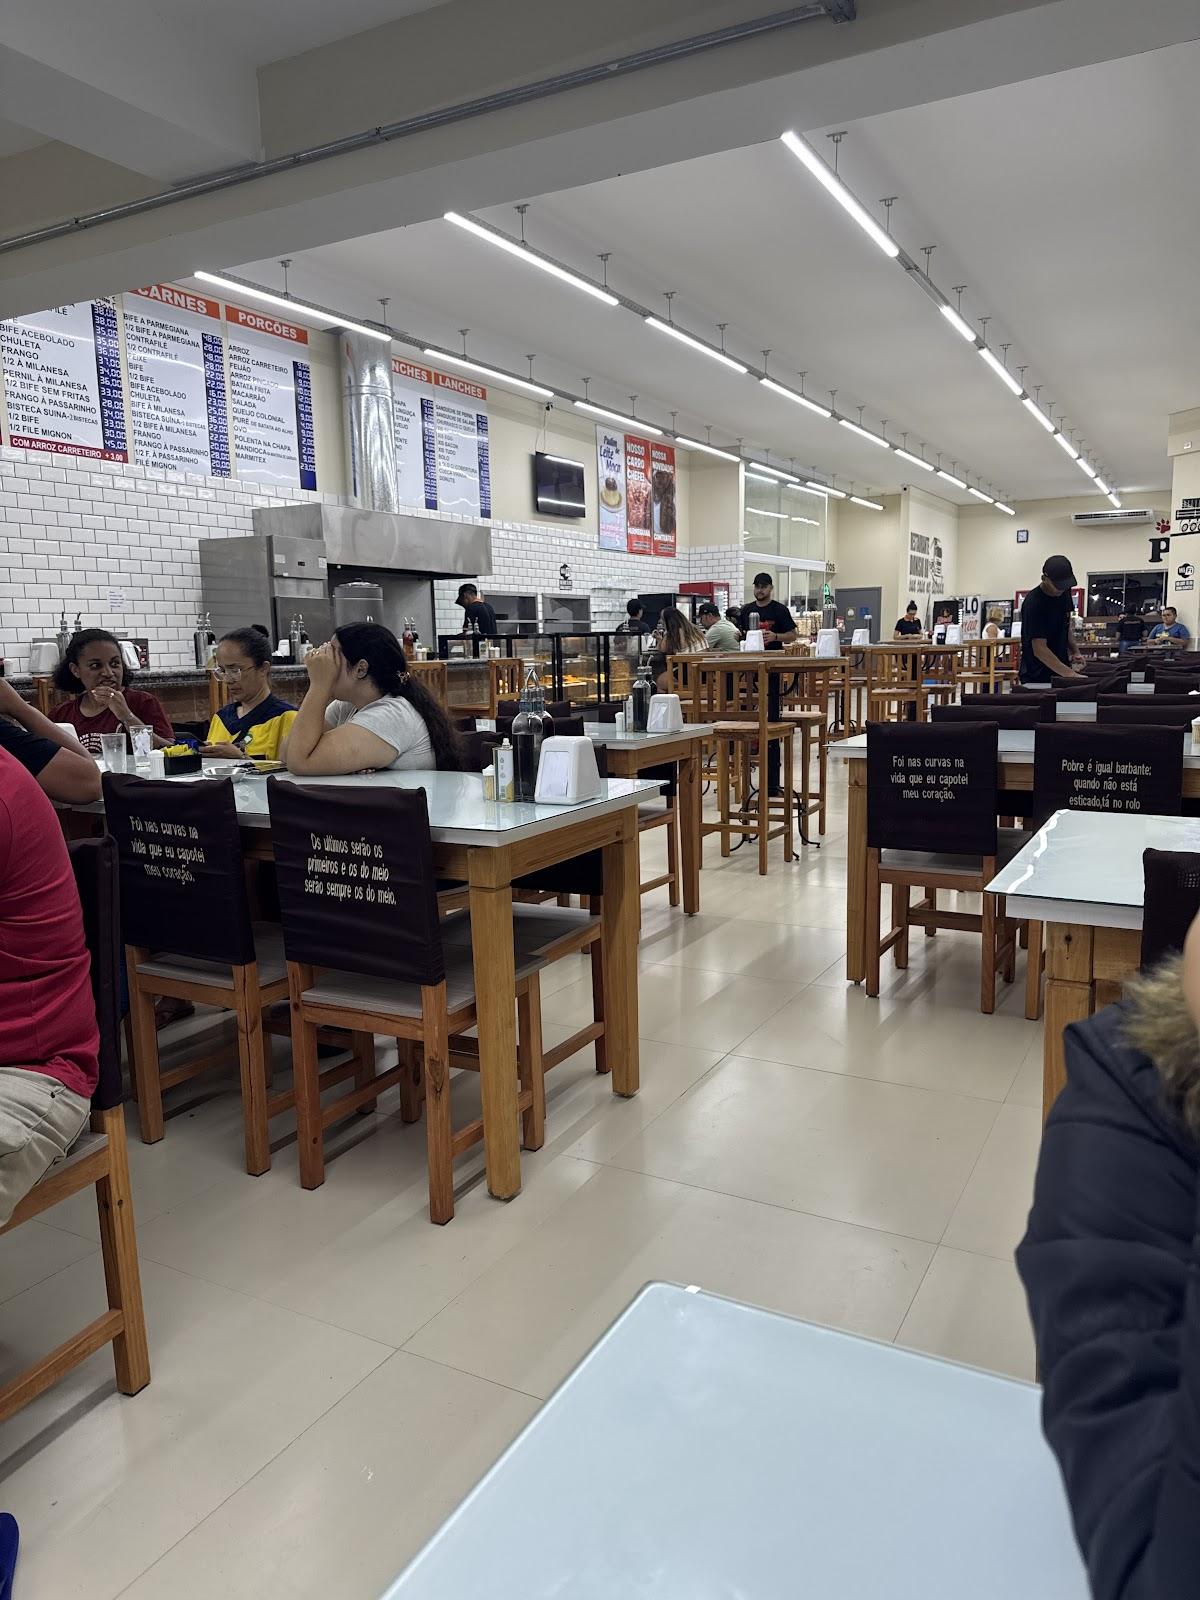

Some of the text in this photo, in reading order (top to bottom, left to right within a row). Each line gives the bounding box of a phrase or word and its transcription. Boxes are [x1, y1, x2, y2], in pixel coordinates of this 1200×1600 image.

[123, 313, 138, 323] BIFE
[147, 319, 189, 336] PARMEGIANA
[0, 324, 74, 348] BIFE ACEBOLADO
[1, 334, 41, 350] CHULETA
[136, 326, 150, 335] BIFE
[159, 332, 200, 348] PARMEGIANA
[2, 346, 38, 360] FRANGO
[229, 345, 250, 355] ARROZ
[229, 354, 250, 364] ARROZ
[3, 357, 14, 366] 1/2
[26, 362, 69, 377] MILANESA
[129, 363, 143, 372] BIFE
[392, 361, 427, 381] NCHES
[3, 369, 35, 381] PERNIL
[46, 377, 87, 391] MILANESA
[139, 374, 154, 383] BIFE
[6, 379, 90, 402] 1/2 BIFE SEM FRITAS
[130, 382, 186, 399] BIFE ACEBOLADO
[439, 375, 482, 398] LANCHES
[5, 390, 39, 402] FRANGO
[49, 399, 96, 414] PASSARINHO
[130, 391, 160, 402] CHULETA
[8, 402, 42, 415] BISTECA
[131, 401, 145, 409] BIFE
[154, 405, 185, 416] MILANESA
[132, 410, 160, 421] BISTECA
[22, 415, 39, 424] BIFE
[42, 429, 72, 440] MIGNON
[134, 430, 161, 440] FRANGO
[144, 422, 158, 430] BIFE
[166, 425, 197, 437] MILANESA
[12, 438, 30, 447] COM
[32, 441, 56, 451] ARROZ
[58, 445, 101, 458] CARRETEIRO
[135, 440, 162, 449] FRANGO
[170, 445, 208, 457] PASSARINHO
[152, 461, 176, 470] MIGNON
[159, 453, 198, 464] PASSARINHO
[893, 756, 964, 768] Foi nas curvas na
[1062, 758, 1151, 775] Pobre é igual barbante:
[890, 772, 968, 787] vida que eu capotei
[1074, 777, 1137, 792] quando não está
[903, 787, 955, 802] meu coração.
[1113, 800, 1122, 808] no
[1126, 798, 1140, 809] rolo
[129, 816, 198, 839] Foi nas curvas na
[131, 838, 205, 864] vida que eu capotei
[311, 833, 321, 850] Os
[351, 837, 371, 856] serão
[374, 845, 383, 858] os
[144, 864, 161, 877] meu
[308, 854, 389, 881] primeiros e os do meio
[305, 875, 396, 905] serão sempre os do meio.
